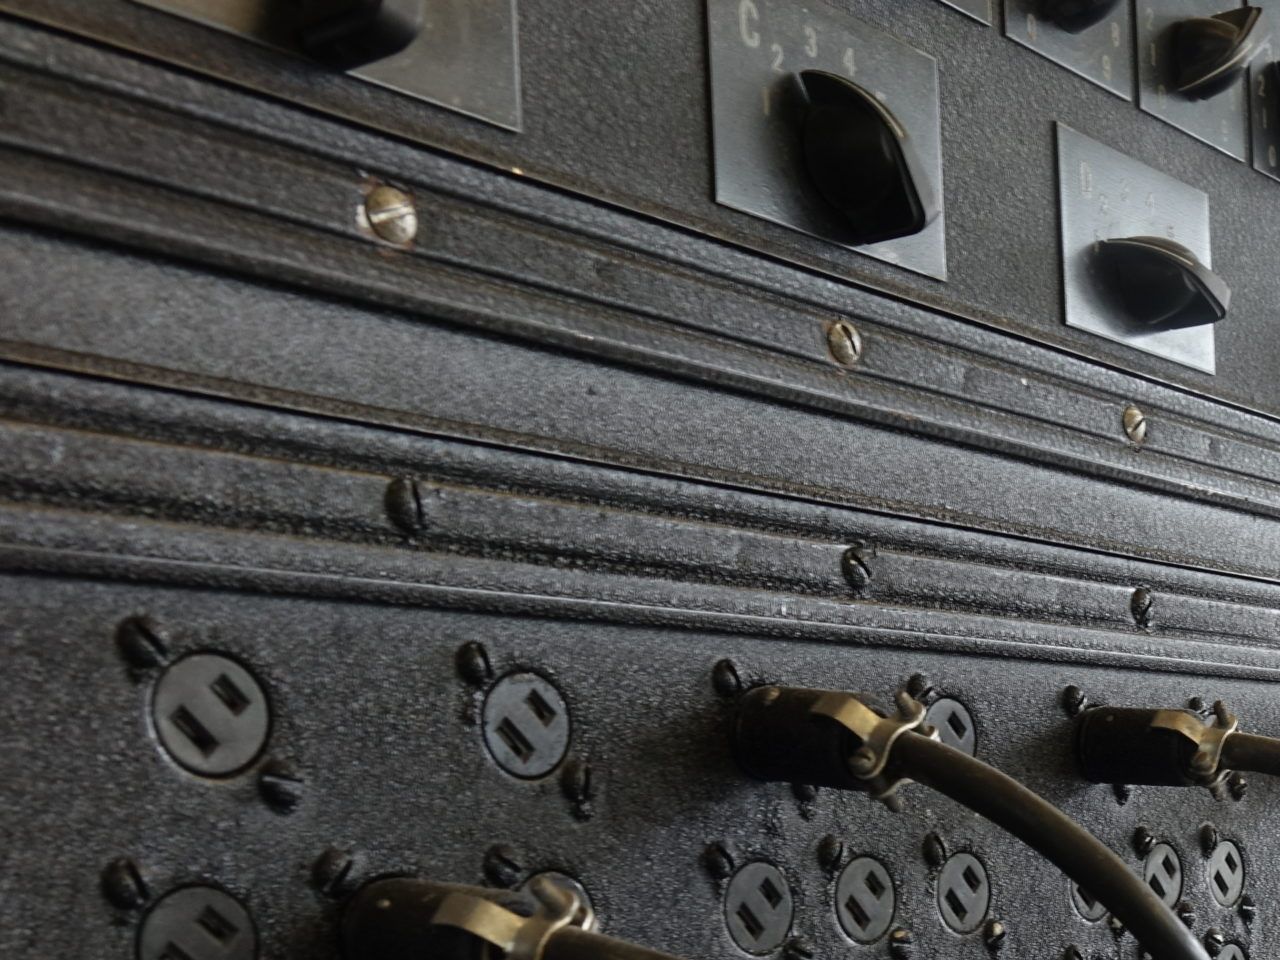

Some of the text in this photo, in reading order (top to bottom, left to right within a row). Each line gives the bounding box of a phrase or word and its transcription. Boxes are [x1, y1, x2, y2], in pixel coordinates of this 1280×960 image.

[739, 0, 761, 48] C
[771, 43, 784, 73] 2
[804, 27, 818, 57] 3
[843, 48, 856, 76] 4
